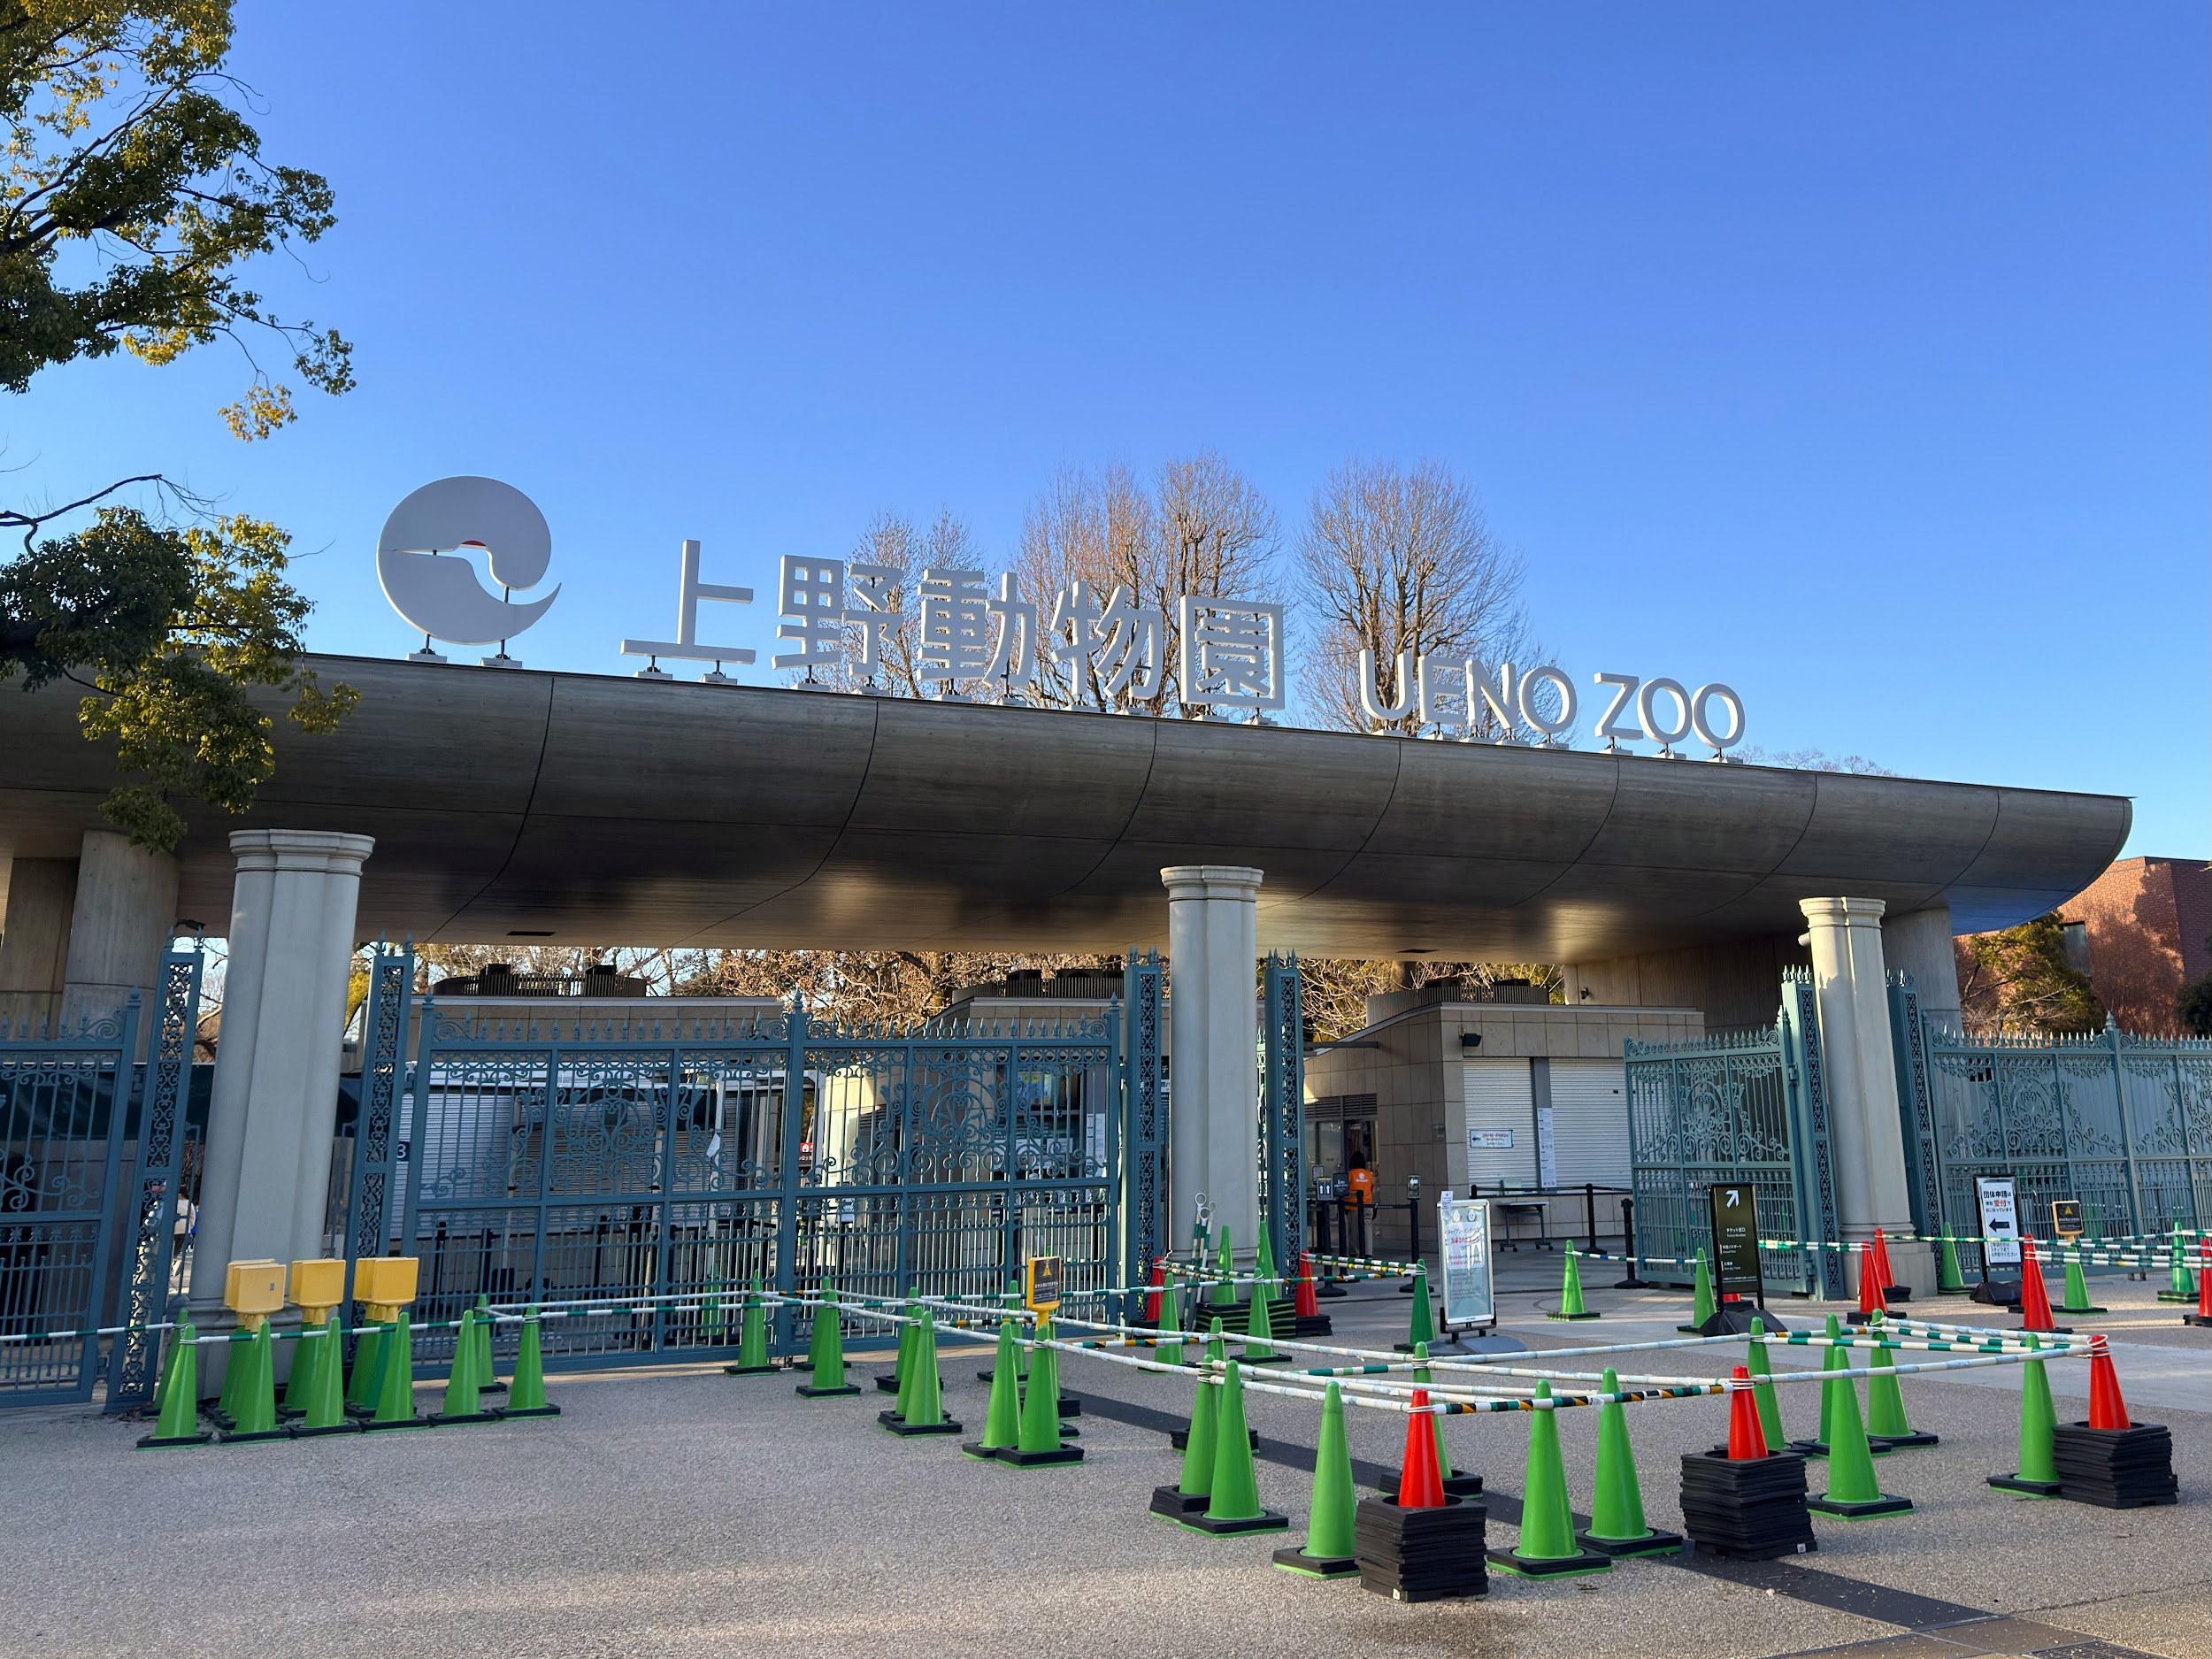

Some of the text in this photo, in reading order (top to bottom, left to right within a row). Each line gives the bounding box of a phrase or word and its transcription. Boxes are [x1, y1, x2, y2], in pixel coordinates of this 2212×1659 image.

[620, 540, 1285, 710] 上野動物園
[1359, 649, 1746, 749] UENO ZOO
[397, 1143, 406, 1159] 3
